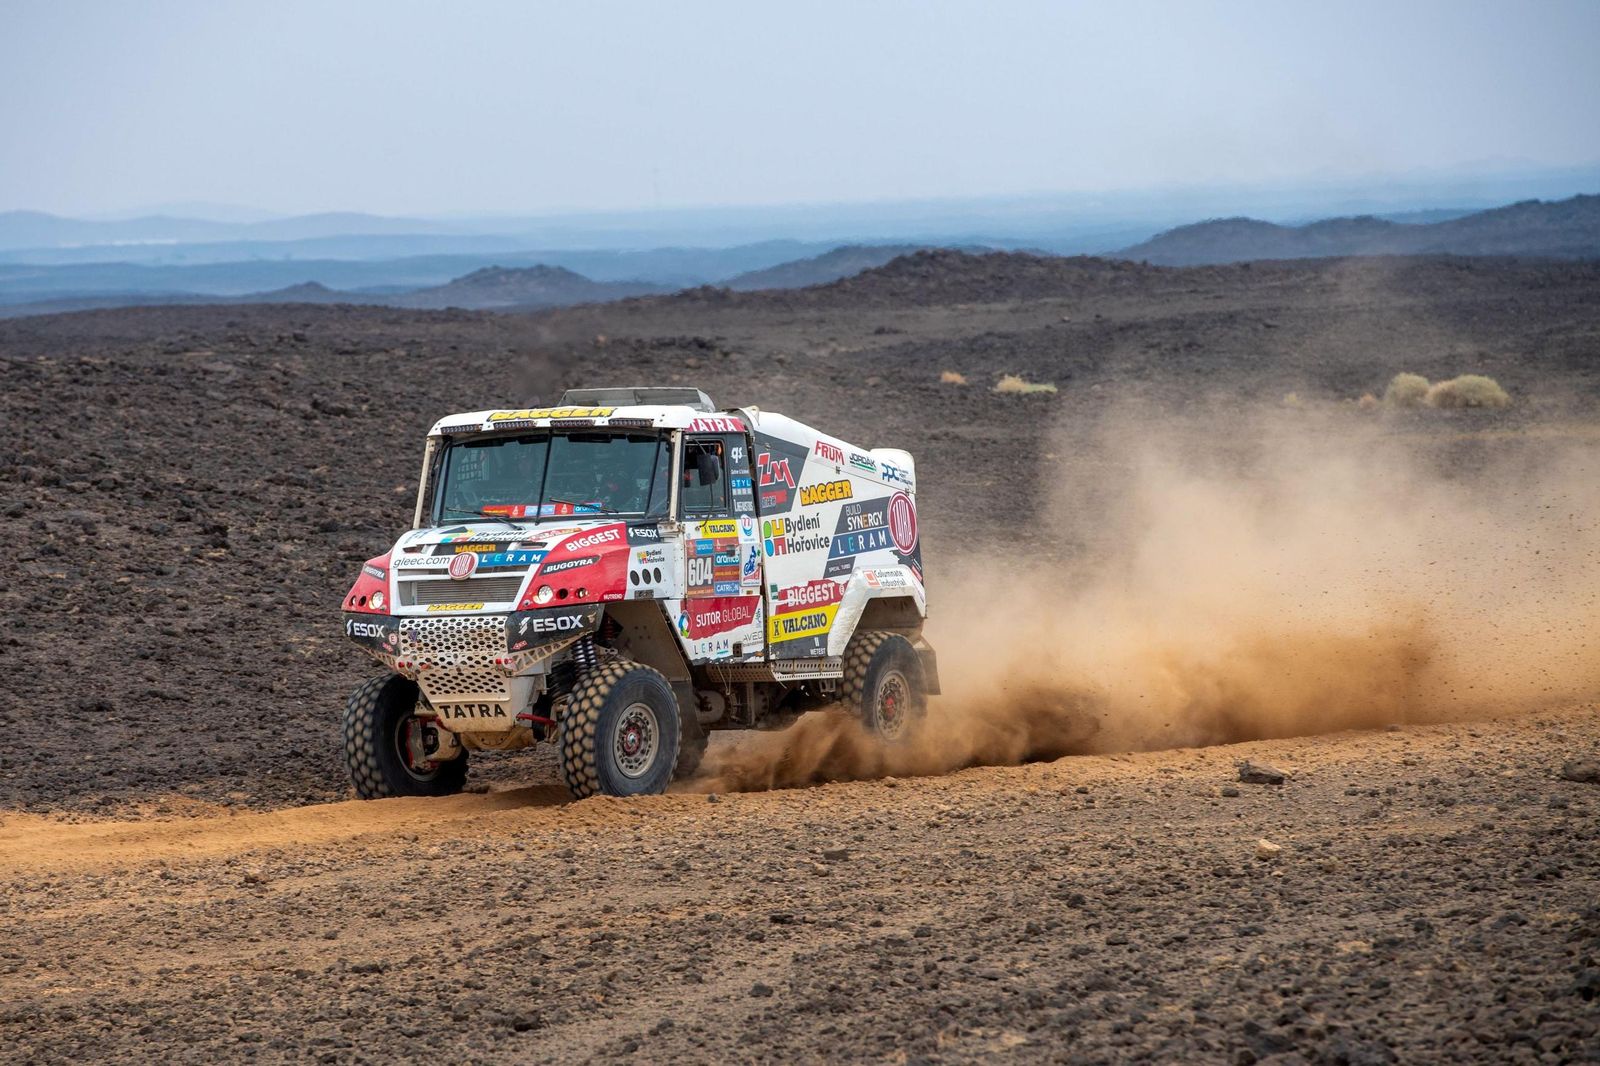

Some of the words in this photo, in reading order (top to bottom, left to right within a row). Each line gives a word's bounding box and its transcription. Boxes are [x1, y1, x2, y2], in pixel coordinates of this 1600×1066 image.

[487, 408, 616, 421] BAGGER
[815, 441, 845, 465] FRUM
[800, 479, 853, 506] BAGGER
[709, 524, 736, 533] VALCANO
[785, 513, 820, 533] Bydlení
[847, 511, 883, 530] SYNERGY
[566, 529, 621, 552] BIGGEST
[635, 527, 658, 540] ESOX
[836, 530, 887, 554] LERAM
[454, 544, 496, 553] BAGGER
[787, 534, 829, 552] Hořovice
[393, 556, 450, 569] gleec.com
[482, 553, 542, 563] LERAM
[546, 557, 593, 573] BUGGYRA
[688, 557, 713, 586] 604
[787, 584, 835, 607] BIGGEST
[533, 615, 584, 633] ESOX
[696, 612, 721, 628] SUTOR
[722, 606, 751, 624] GLOBAL
[782, 613, 828, 634] VALCANO
[353, 623, 385, 638] ESOX
[695, 639, 729, 655] LERAM
[439, 704, 506, 719] TATRA
